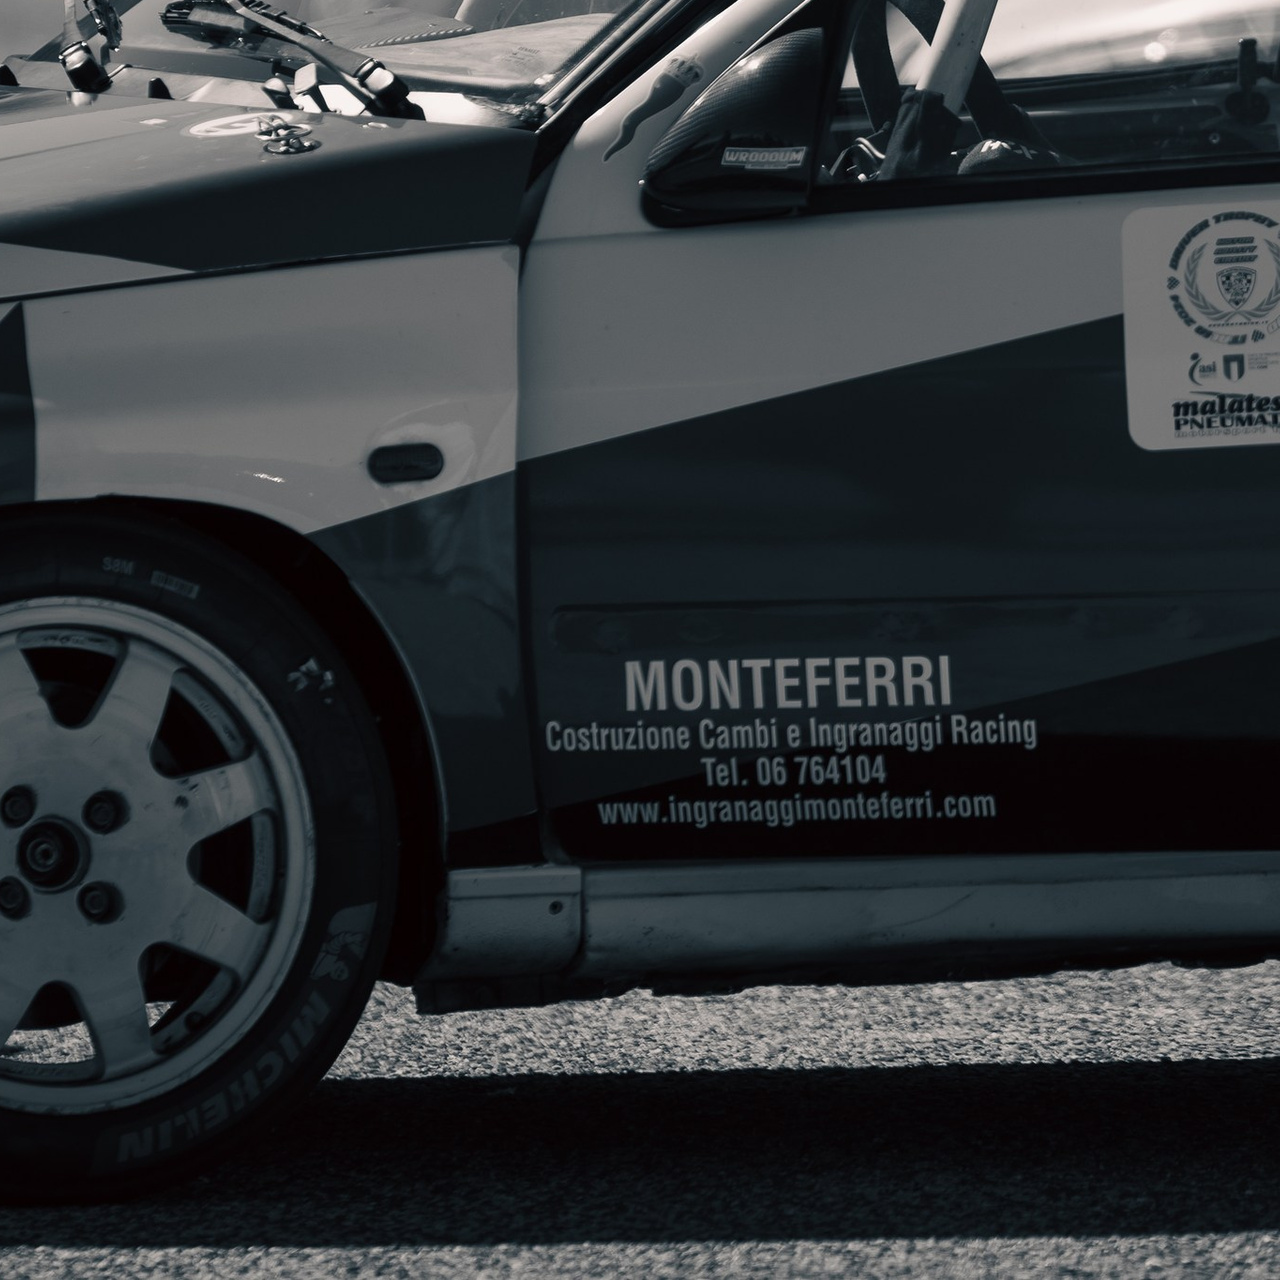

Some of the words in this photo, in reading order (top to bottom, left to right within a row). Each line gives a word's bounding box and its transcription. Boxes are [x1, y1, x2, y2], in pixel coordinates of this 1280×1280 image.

[1212, 210, 1280, 229] TROPHY
[624, 655, 952, 712] MONTEFERRI
[545, 719, 691, 752] Costruzione
[699, 717, 778, 750] Cambi
[786, 724, 801, 749] e
[809, 715, 942, 753] Ingranaggi
[950, 713, 1038, 750] Racing
[700, 756, 748, 787] Tel.
[755, 757, 788, 786] 06
[793, 755, 887, 785] 764104
[597, 791, 998, 828] www.ingranaggimonteferri.com
[117, 990, 330, 1163] MICHELIN
